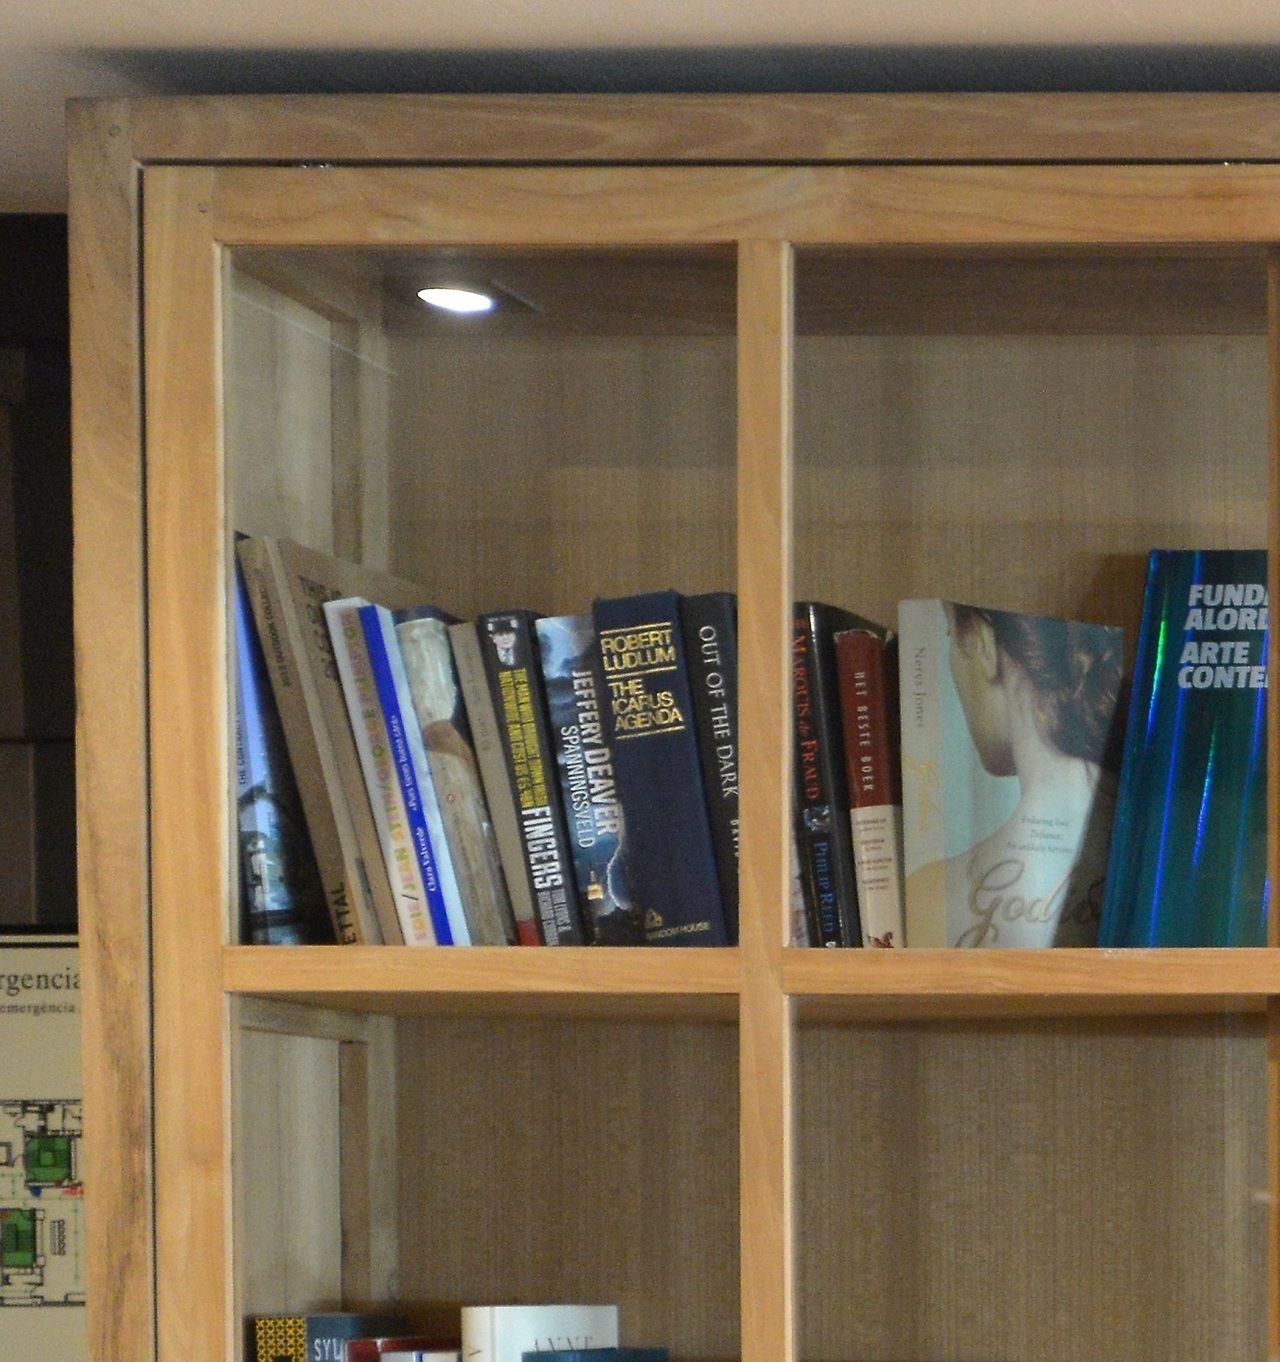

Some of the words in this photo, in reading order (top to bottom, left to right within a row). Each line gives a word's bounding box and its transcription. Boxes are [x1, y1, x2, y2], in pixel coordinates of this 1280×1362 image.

[601, 630, 672, 652] ROBERT
[700, 626, 720, 665] OUT
[1179, 642, 1249, 664] ARTE
[604, 648, 675, 670] LUDLUM
[609, 679, 644, 698] THE
[706, 672, 724, 697] OF
[854, 671, 866, 697] HET
[572, 671, 601, 747] JEFFERY
[613, 692, 674, 714] ICARUS
[616, 711, 683, 731] AGENDA
[710, 704, 730, 738] THE
[856, 704, 869, 747] BESTE
[561, 726, 596, 848] SPANNINGSVELD
[716, 746, 738, 798] DARK
[861, 754, 875, 792] BOEK
[585, 747, 619, 835] DEAVER
[522, 806, 562, 889] FINGERS
